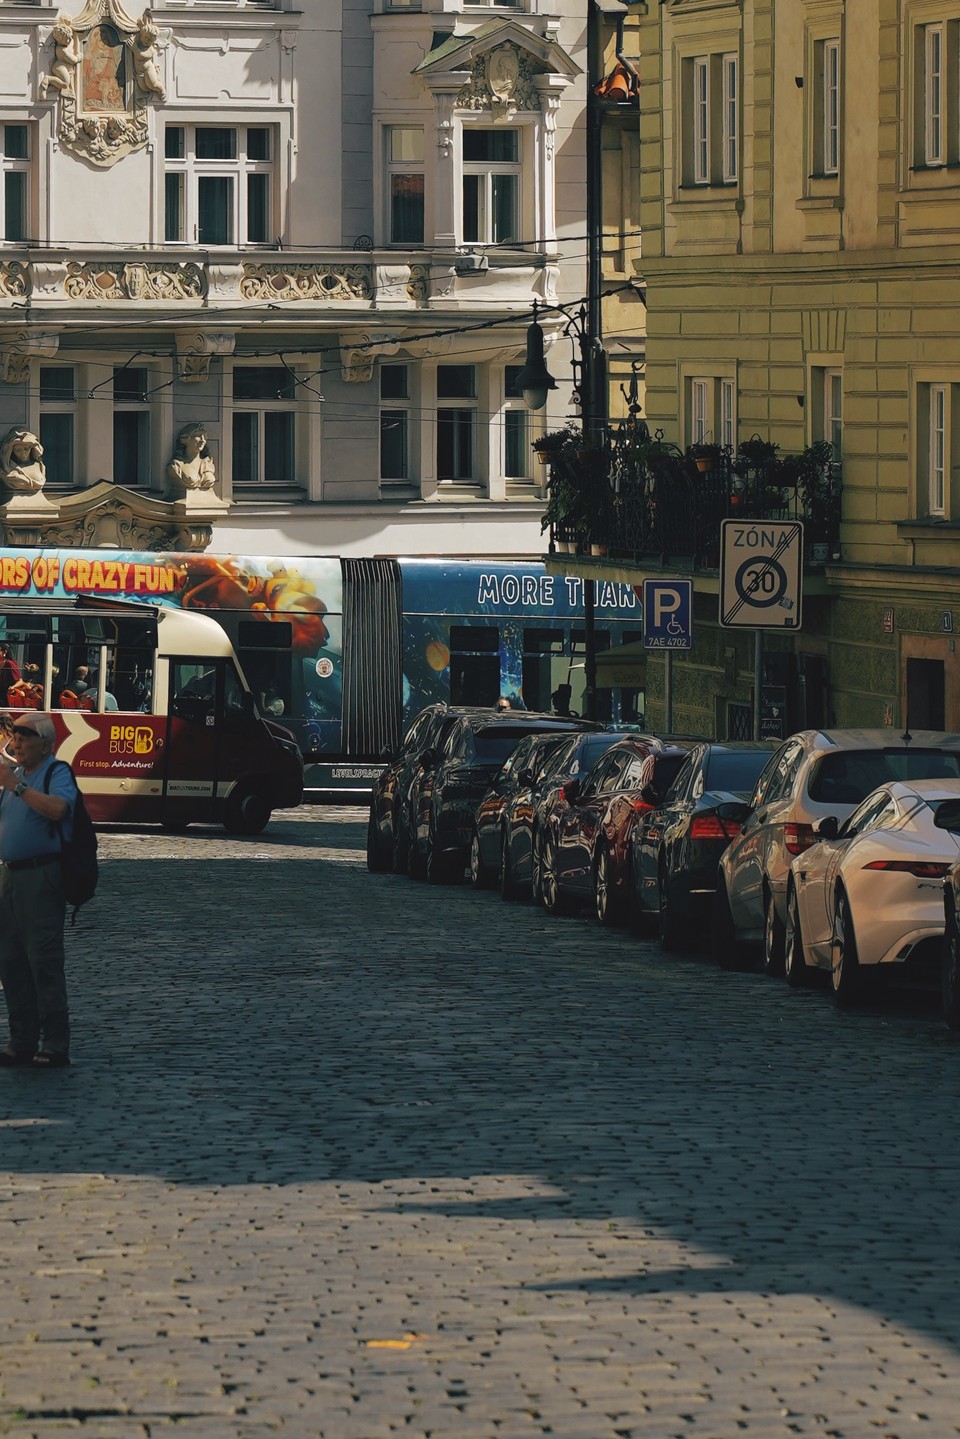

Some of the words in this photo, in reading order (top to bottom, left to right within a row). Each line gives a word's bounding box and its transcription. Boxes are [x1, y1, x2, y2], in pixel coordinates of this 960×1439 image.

[733, 526, 790, 549] ZÓNA
[32, 558, 60, 589] OF
[63, 558, 131, 591] CRAZY
[134, 562, 175, 592] FUN
[746, 570, 775, 593] 30
[478, 574, 555, 606] MORE
[654, 588, 681, 628] P
[648, 638, 665, 647] 7AE
[667, 638, 687, 647] 4702
[110, 725, 135, 741] BIG
[109, 740, 134, 754] BUS
[79, 760, 95, 768] First
